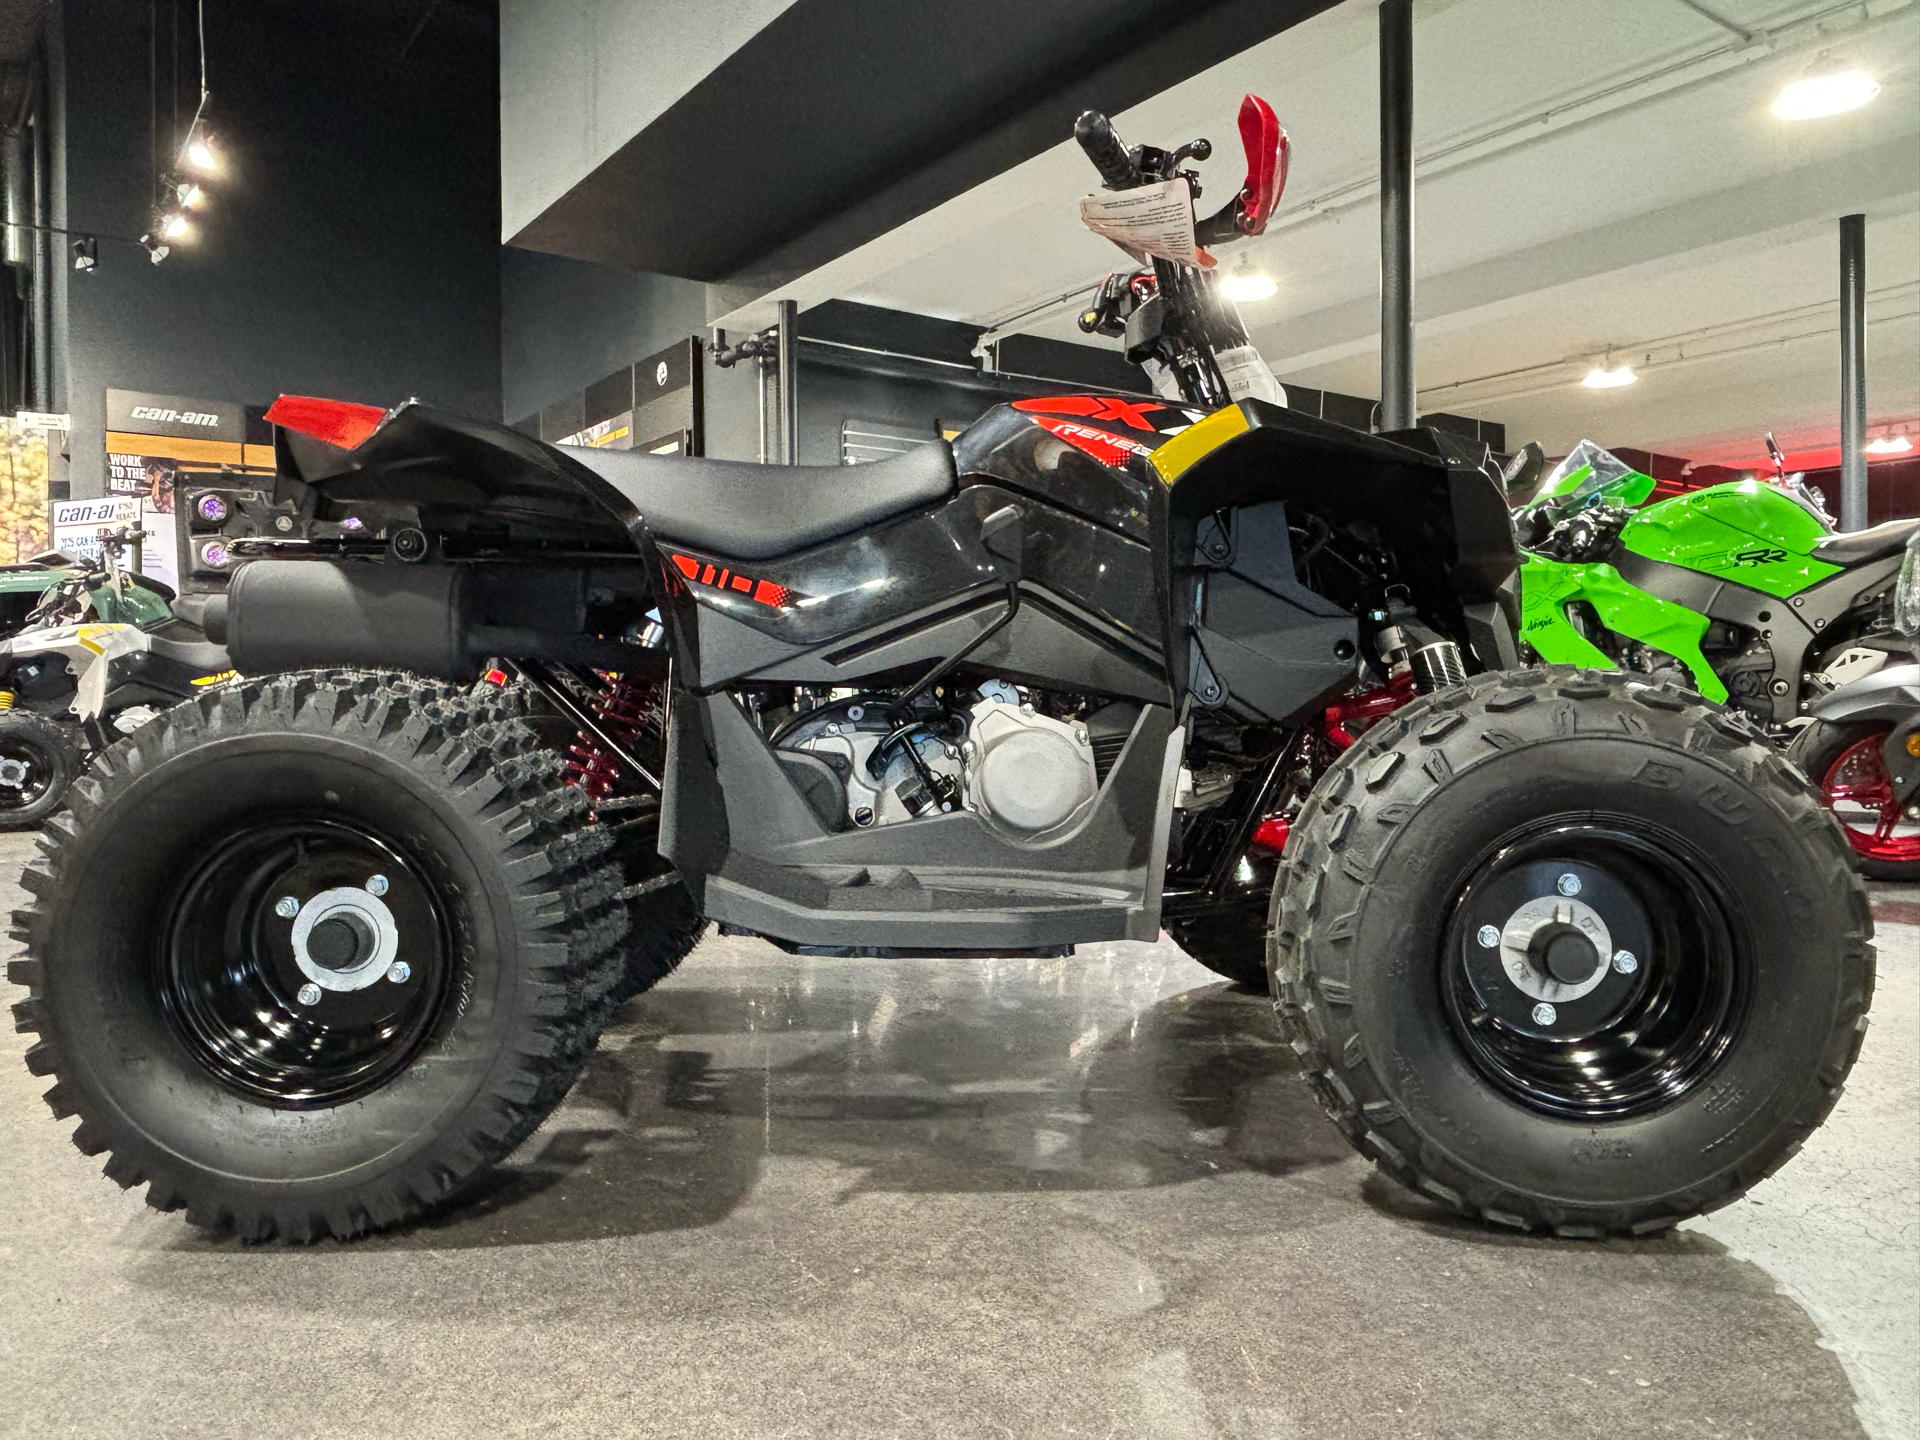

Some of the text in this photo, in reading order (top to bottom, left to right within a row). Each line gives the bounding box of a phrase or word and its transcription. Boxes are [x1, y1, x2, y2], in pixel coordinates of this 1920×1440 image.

[131, 406, 219, 427] can-am
[109, 453, 142, 467] WORK
[110, 465, 147, 480] TO THE
[110, 478, 137, 492] BEAT
